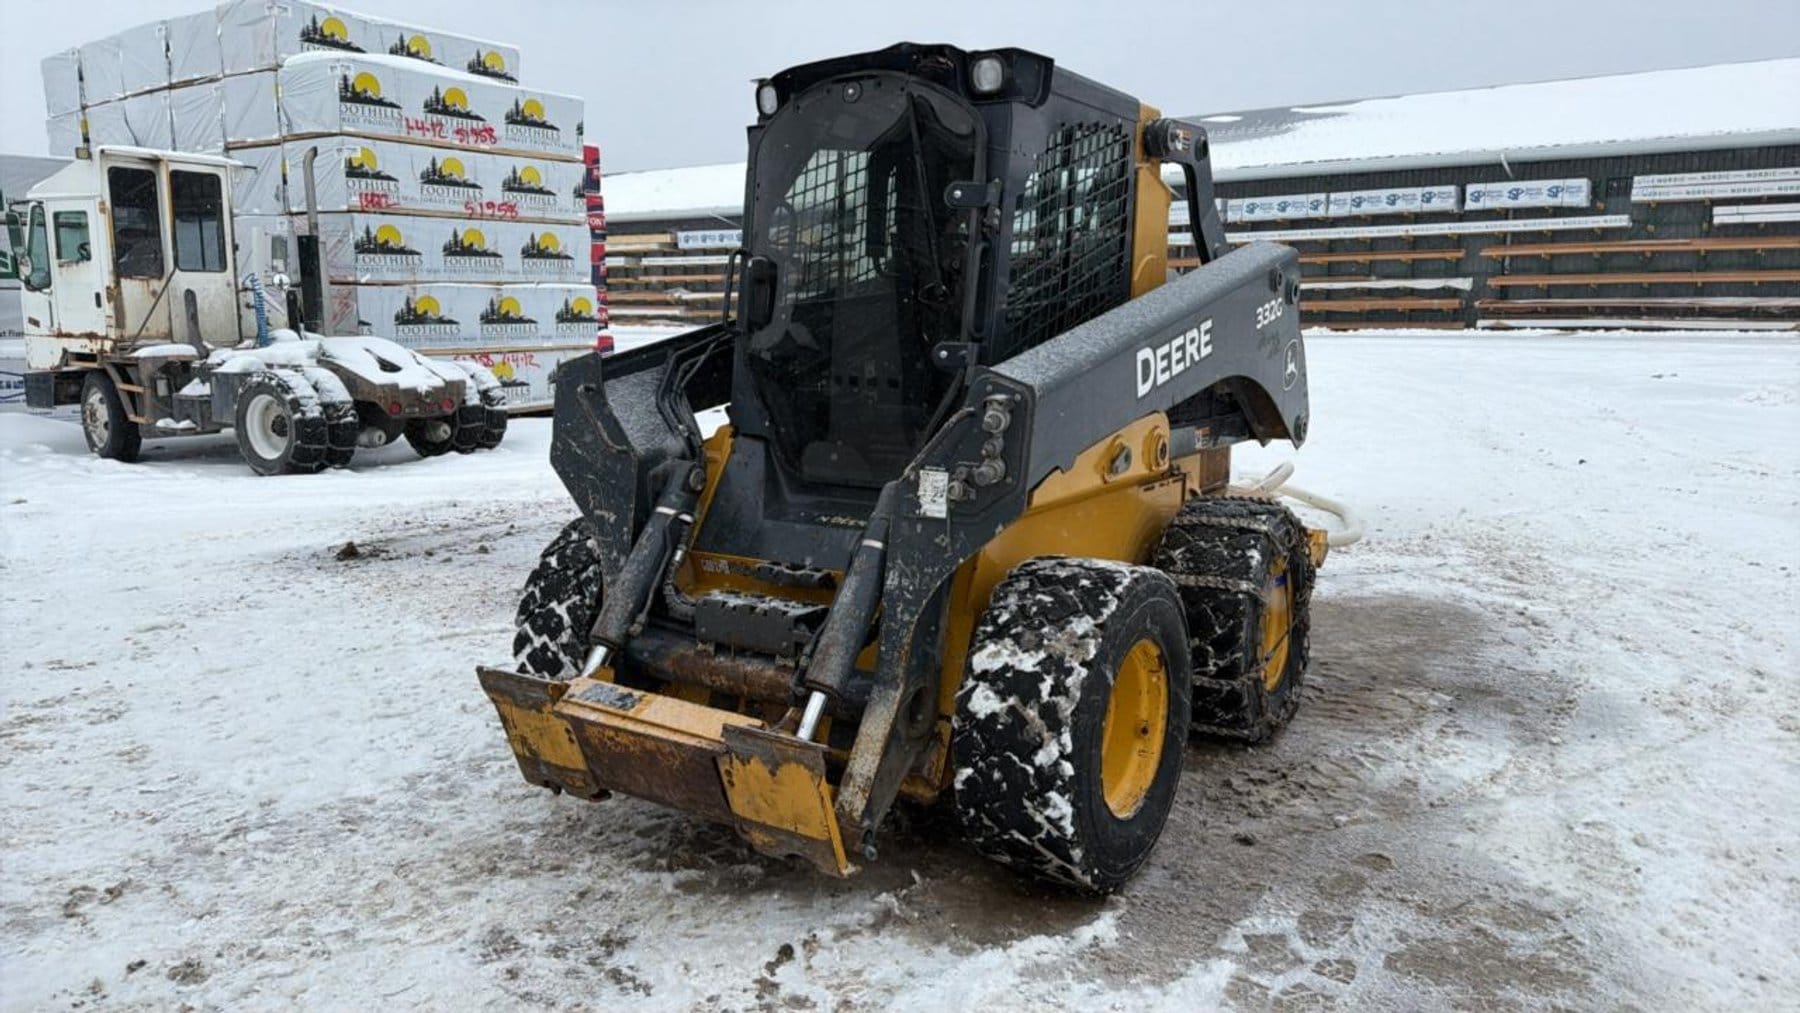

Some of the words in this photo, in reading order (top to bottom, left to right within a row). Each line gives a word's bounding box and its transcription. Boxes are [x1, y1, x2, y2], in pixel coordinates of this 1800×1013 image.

[340, 103, 403, 119] OOTHILLS
[345, 179, 400, 192] OTHILLS
[420, 185, 484, 200] FOOTHILLS
[354, 254, 424, 267] FOOTHILLS
[443, 256, 505, 269] FOOTHILLS
[1255, 297, 1284, 331] 332G
[394, 325, 462, 336] FOOTHILLS
[480, 323, 540, 335] FOOTHILLS
[555, 323, 598, 335] FOOTHI
[1135, 318, 1213, 400] DEERE
